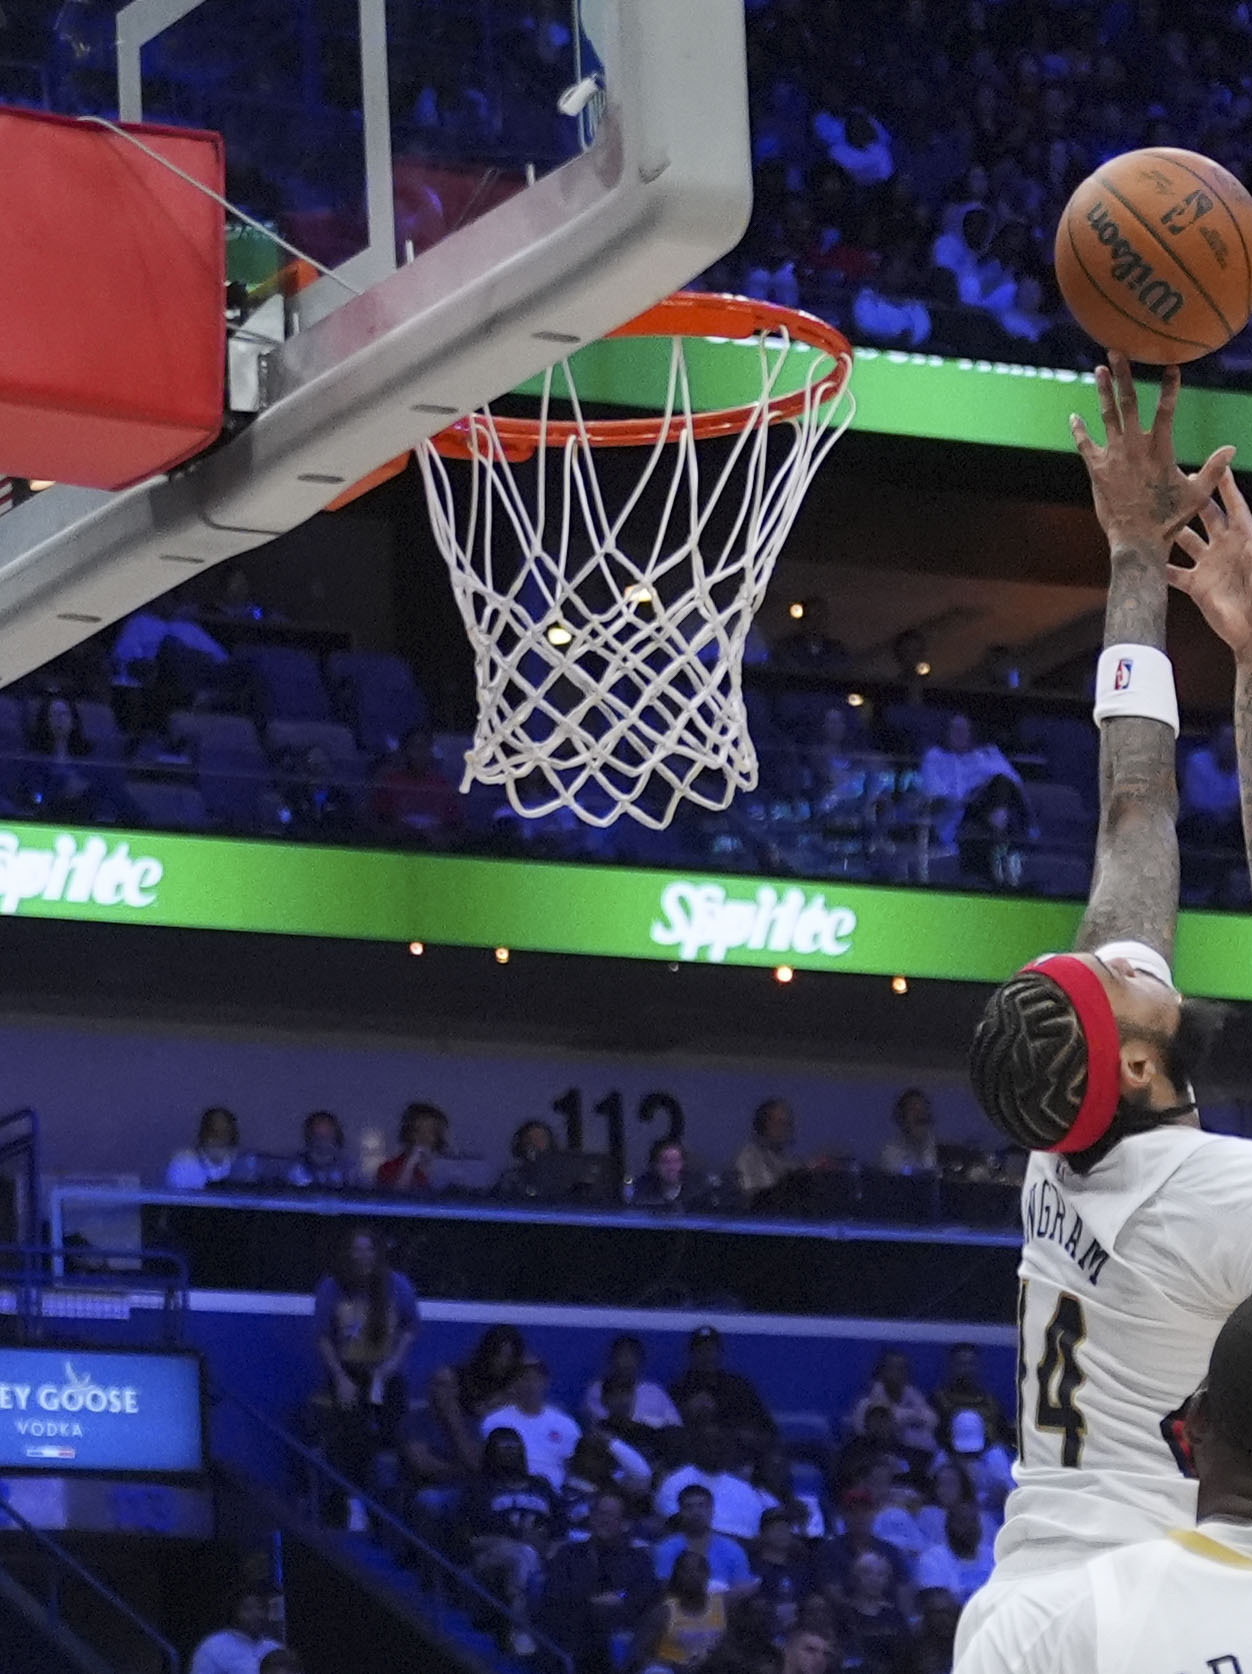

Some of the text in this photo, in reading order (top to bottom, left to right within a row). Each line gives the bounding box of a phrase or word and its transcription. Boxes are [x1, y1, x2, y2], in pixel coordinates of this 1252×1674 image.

[1087, 202, 1184, 324] Wilson
[651, 881, 857, 963] Sprite
[38, 1385, 139, 1414] GOOSE
[16, 1420, 83, 1438] VODKA
